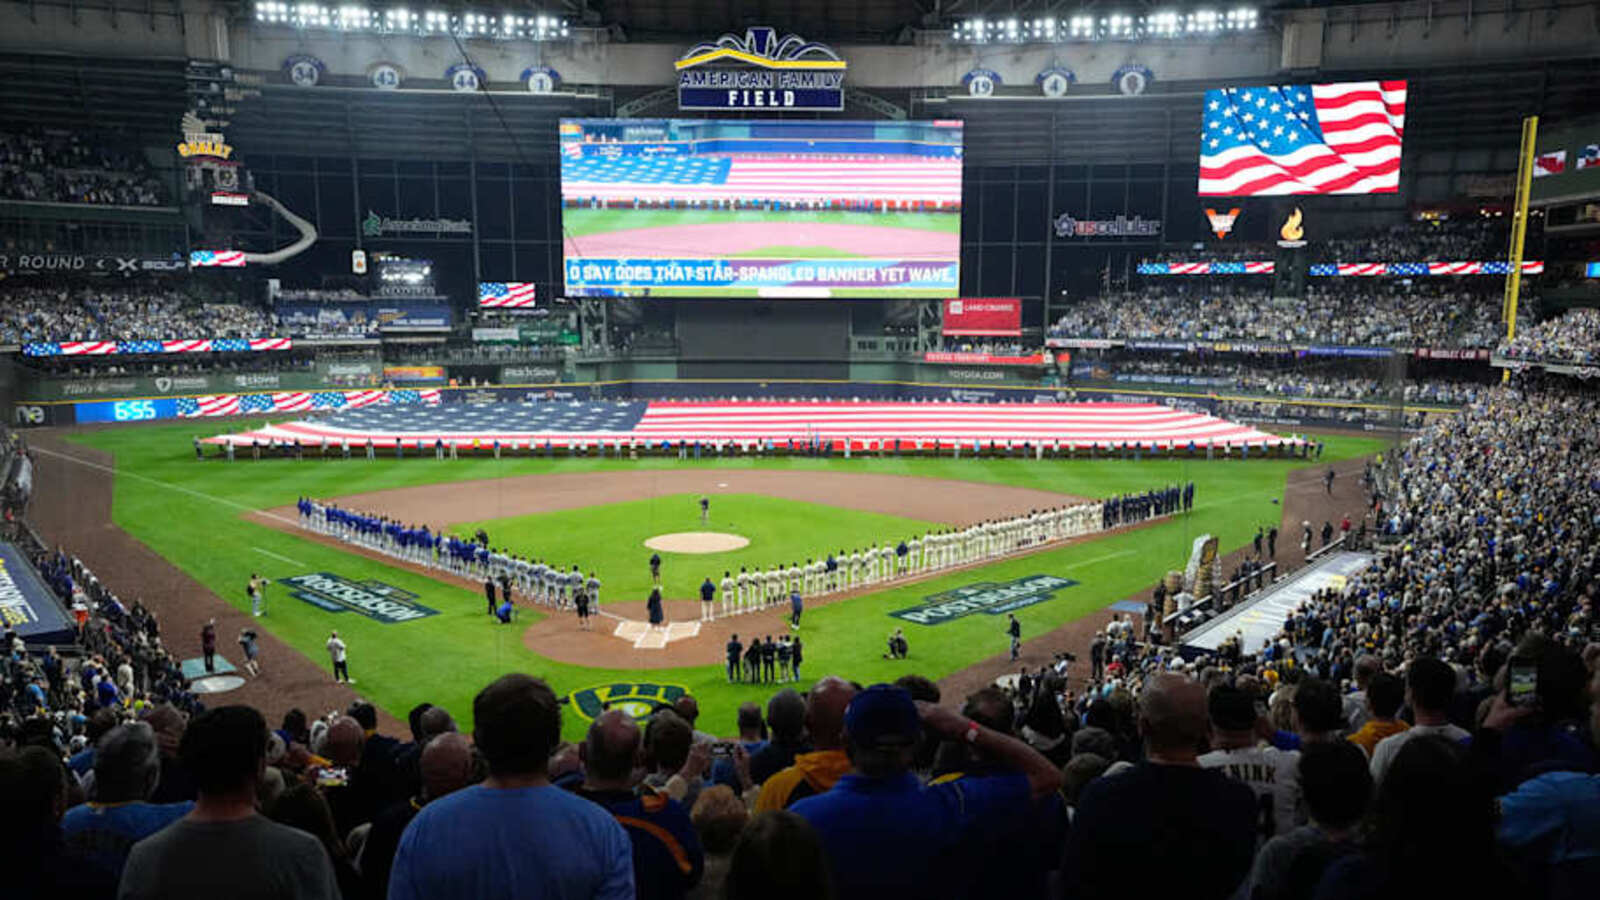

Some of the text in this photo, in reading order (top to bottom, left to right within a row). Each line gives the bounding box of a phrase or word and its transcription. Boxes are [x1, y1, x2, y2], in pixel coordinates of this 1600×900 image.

[295, 66, 315, 81] 34
[680, 71, 844, 89] AMERICAN FAMILY
[456, 75, 475, 88] 44
[973, 80, 990, 94] 19
[1049, 80, 1059, 93] 4
[728, 90, 796, 106] FIELD
[18, 256, 85, 270] ROUND
[570, 265, 580, 280] O
[584, 265, 612, 280] SAY
[616, 265, 651, 280] DOES
[656, 265, 693, 281] THAT
[696, 265, 815, 282] STAR-SPANGLED
[818, 266, 877, 282] BANNER
[879, 267, 906, 282] YET
[113, 401, 156, 421] 6:55
